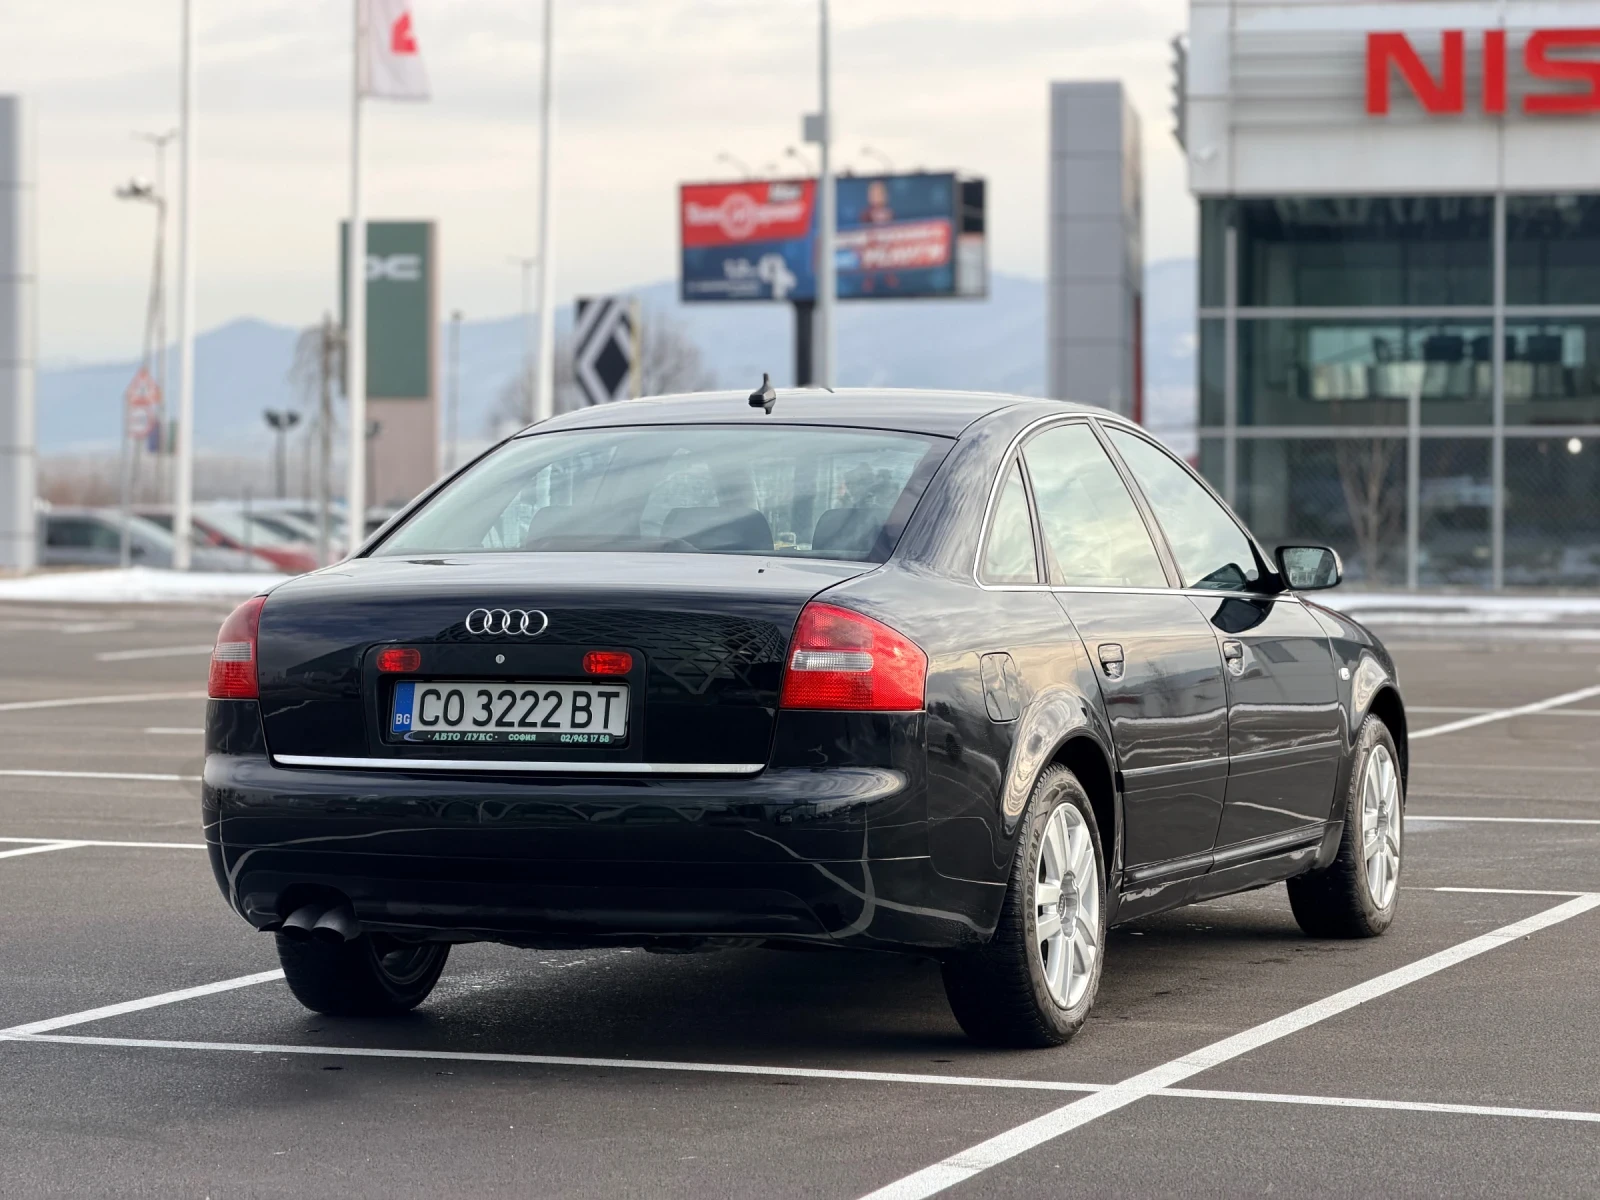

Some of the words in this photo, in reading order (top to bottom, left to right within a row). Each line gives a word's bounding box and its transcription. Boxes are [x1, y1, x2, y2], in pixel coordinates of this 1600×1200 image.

[1367, 29, 1600, 115] NIS
[395, 714, 411, 725] BG
[472, 689, 563, 728] 3222
[432, 732, 460, 741] АВТО
[464, 732, 493, 741] ЛУКС
[508, 733, 536, 741] СОФИЯ
